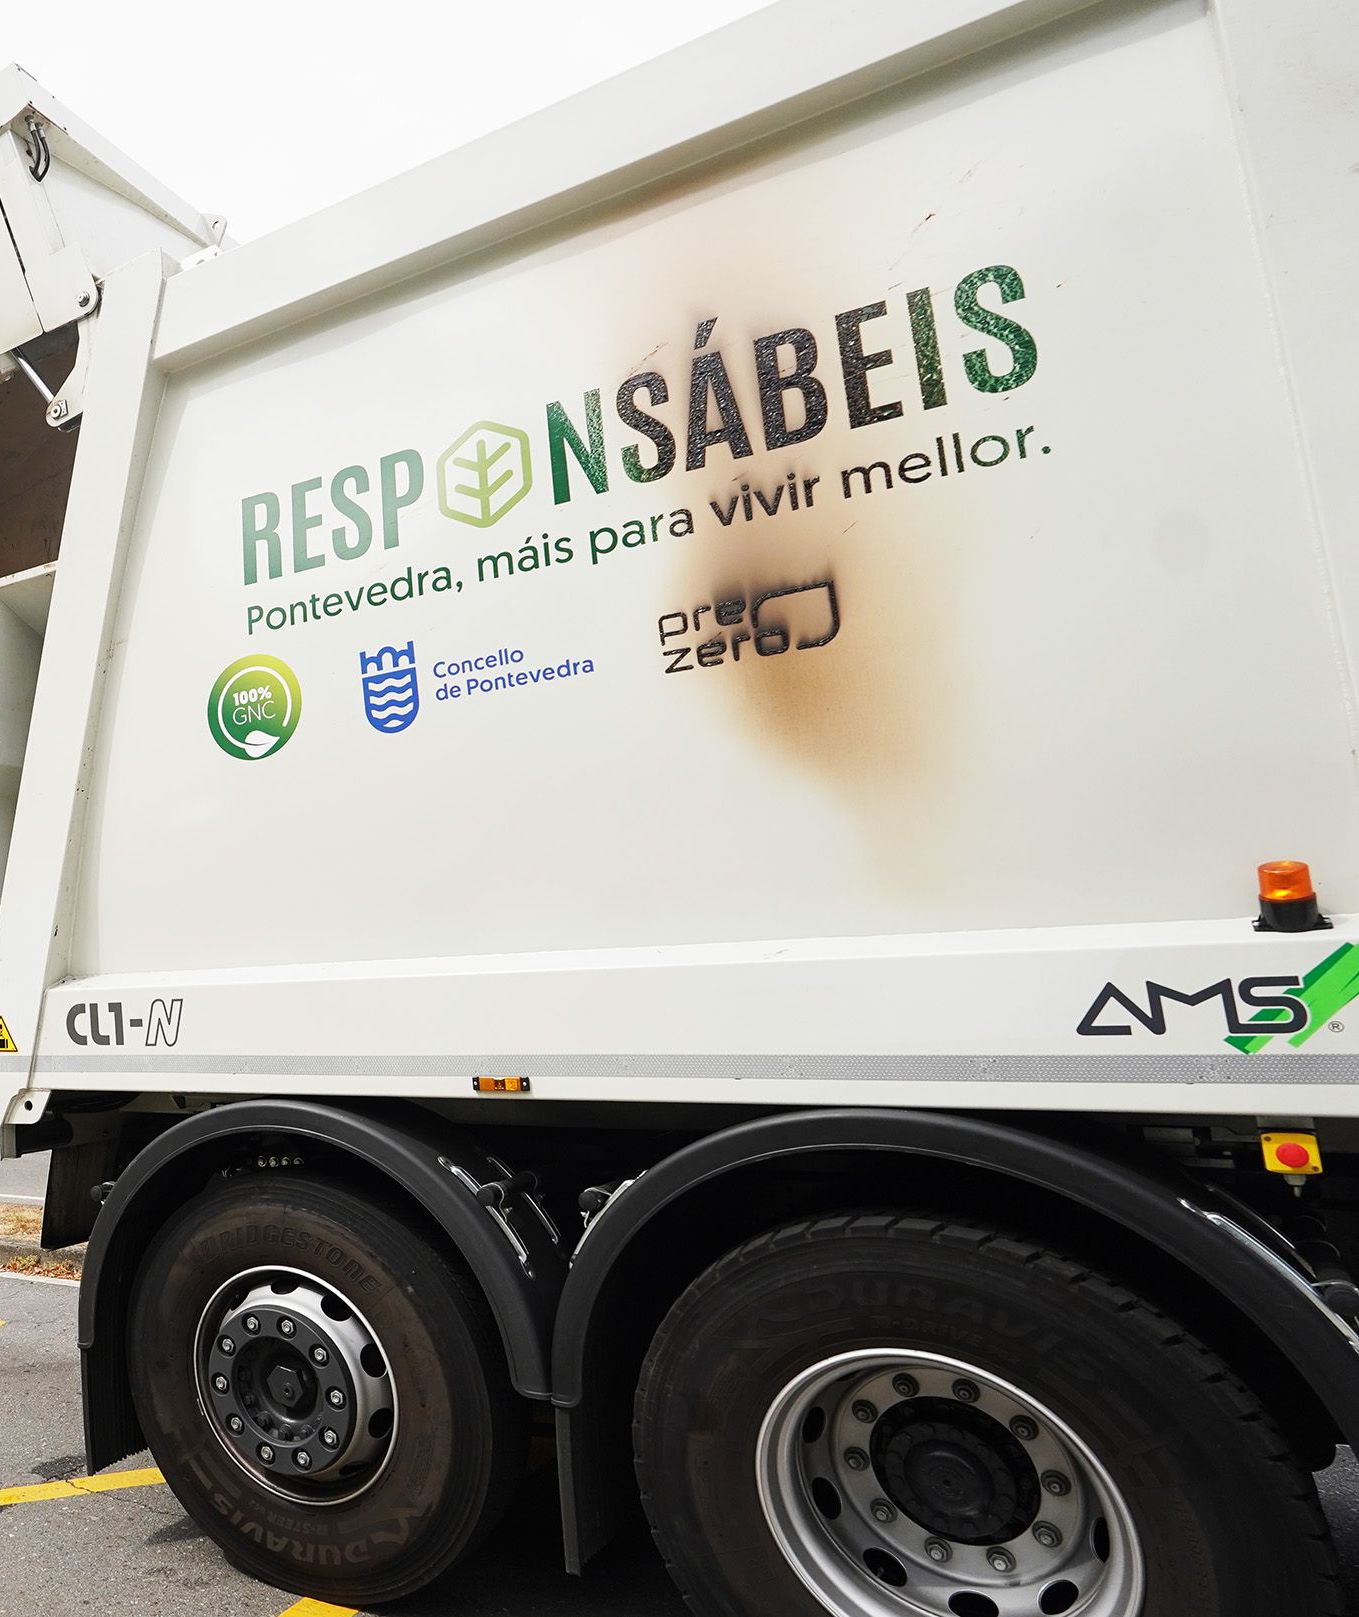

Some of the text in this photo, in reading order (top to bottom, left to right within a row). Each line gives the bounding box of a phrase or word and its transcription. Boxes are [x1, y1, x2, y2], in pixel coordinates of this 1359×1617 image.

[246, 424, 1053, 636] Pontevedra, máis para vivir mellor.
[658, 599, 747, 646] pre
[432, 648, 525, 679] Concello
[663, 629, 790, 674] zero
[232, 685, 273, 707] 100%
[435, 657, 595, 701] de Pontevedra
[232, 701, 276, 726] GNC
[66, 998, 183, 1047] CL1-N
[1076, 975, 1308, 1035] AMS
